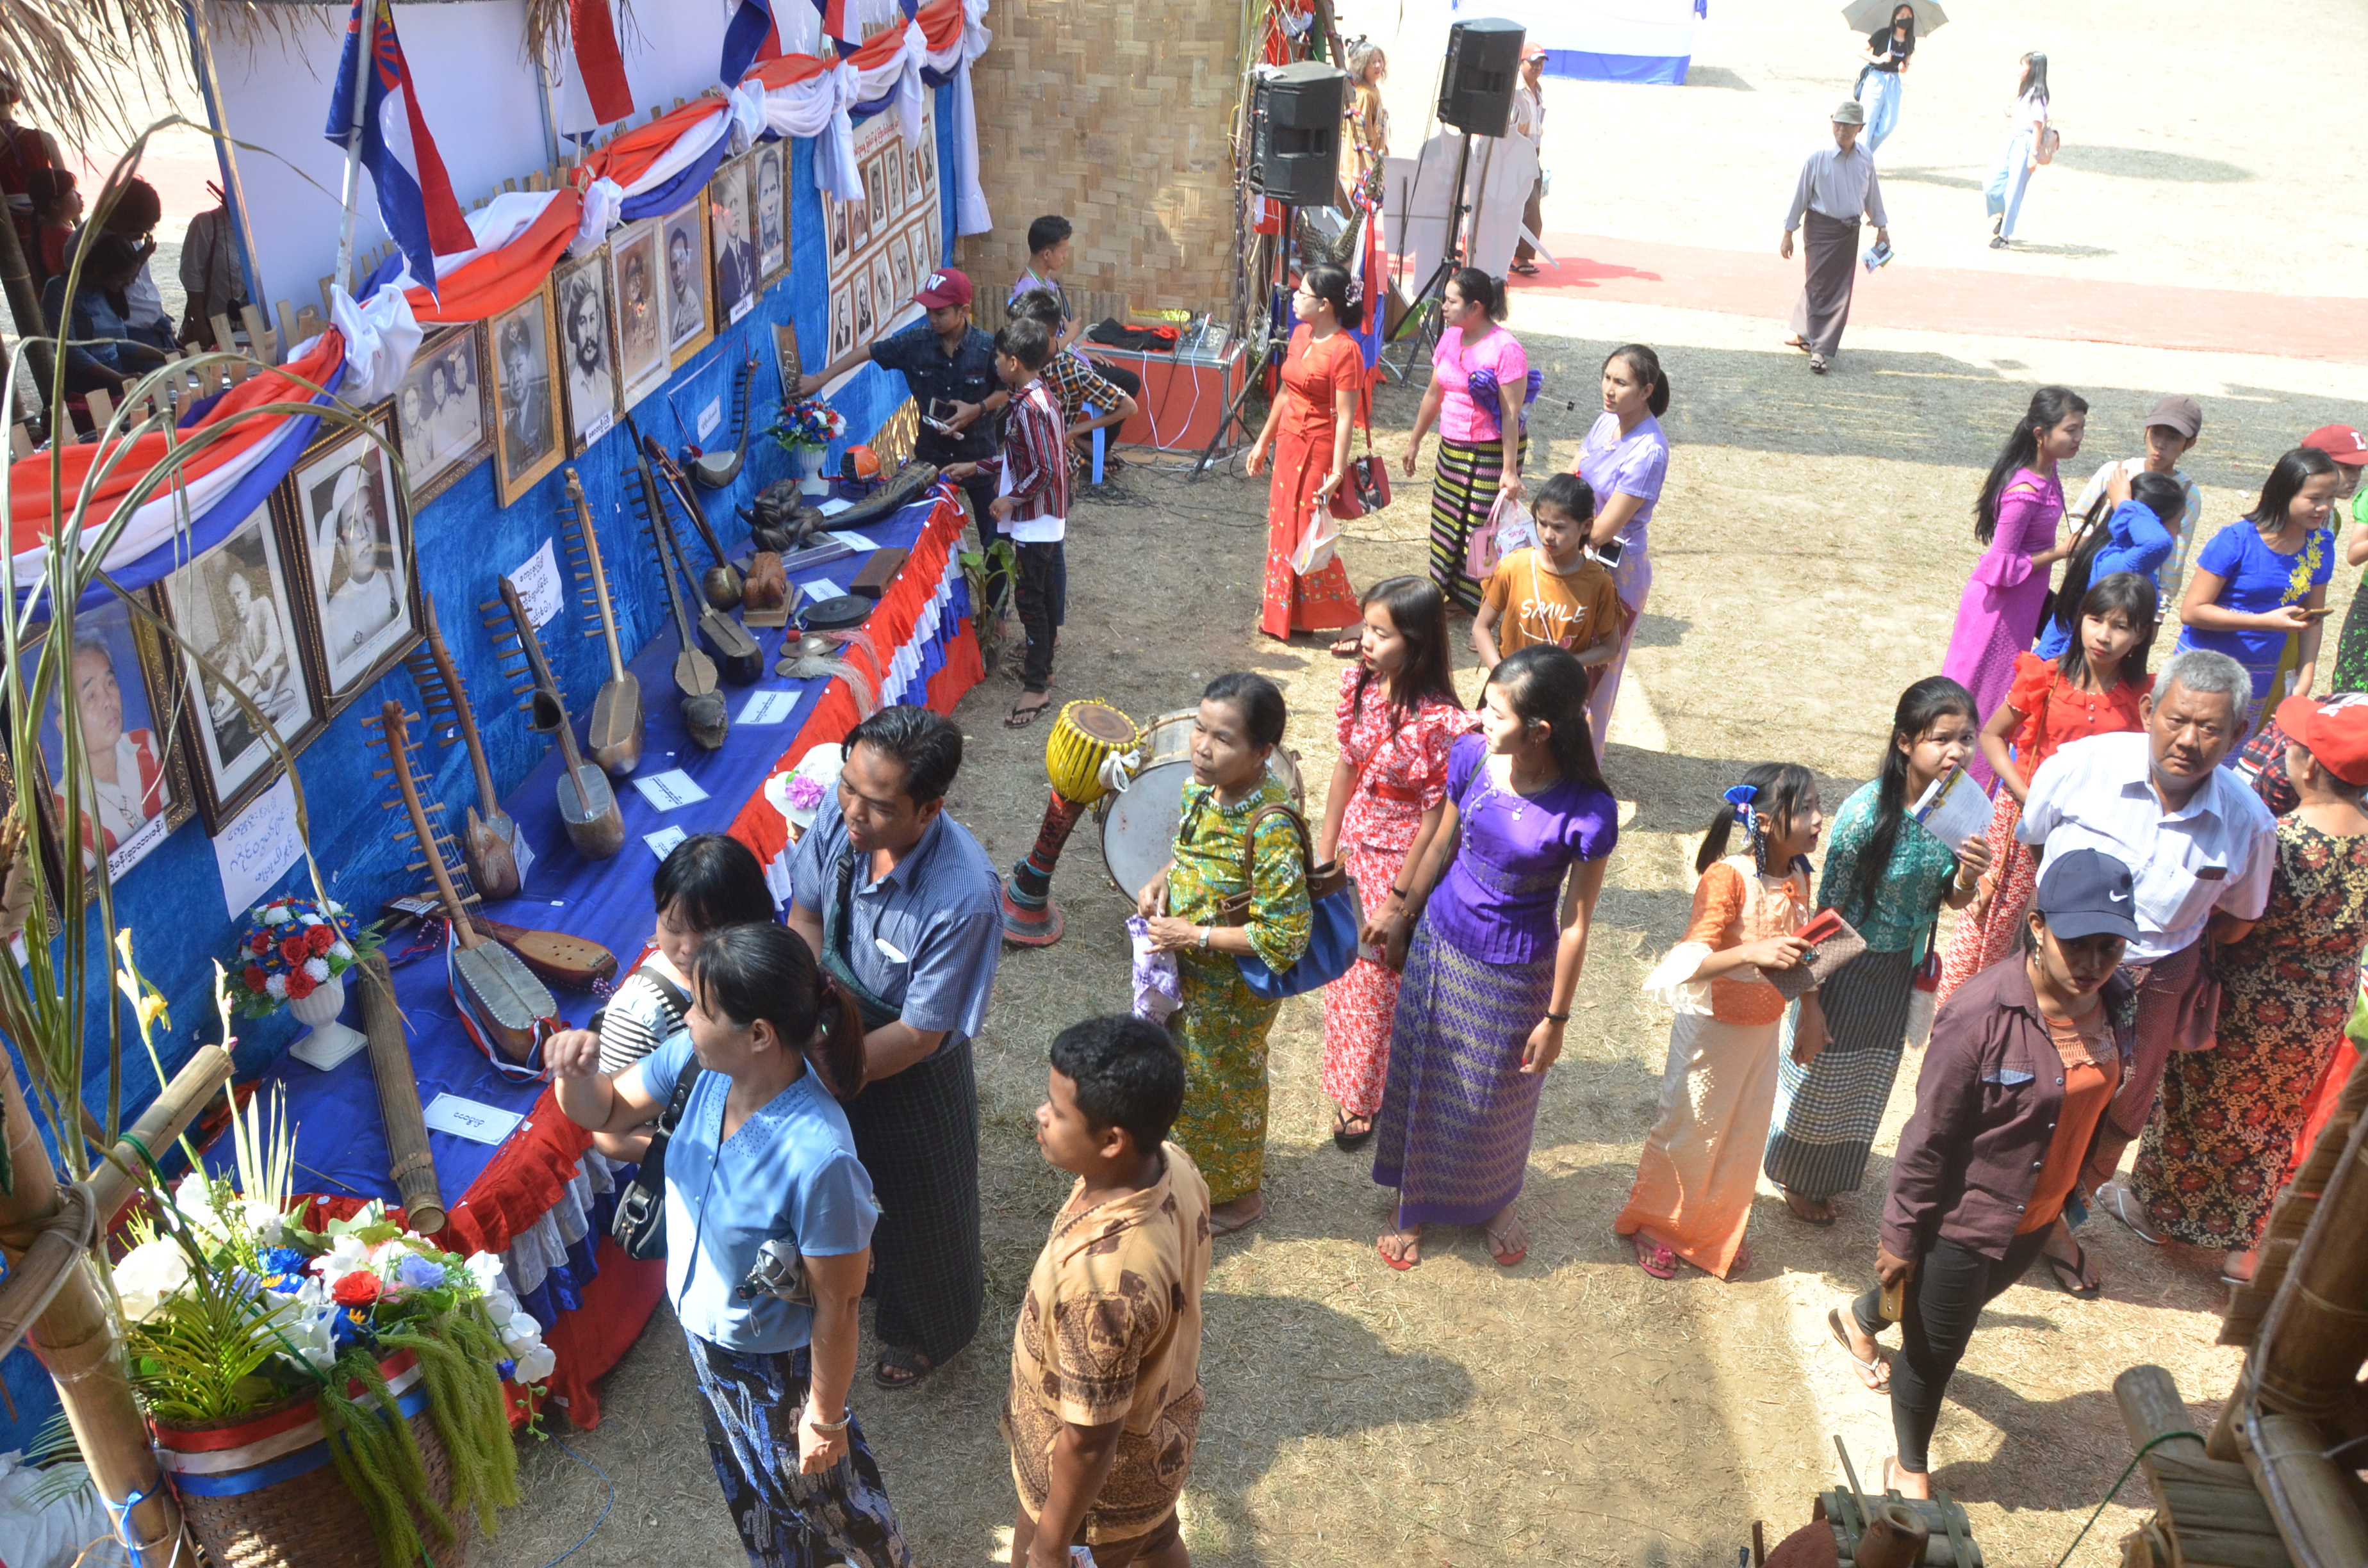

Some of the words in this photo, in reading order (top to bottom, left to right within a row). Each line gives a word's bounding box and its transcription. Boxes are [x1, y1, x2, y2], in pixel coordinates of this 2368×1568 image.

[926, 274, 946, 291] W
[2350, 432, 2367, 450] L
[1520, 598, 1588, 623] SMILE
